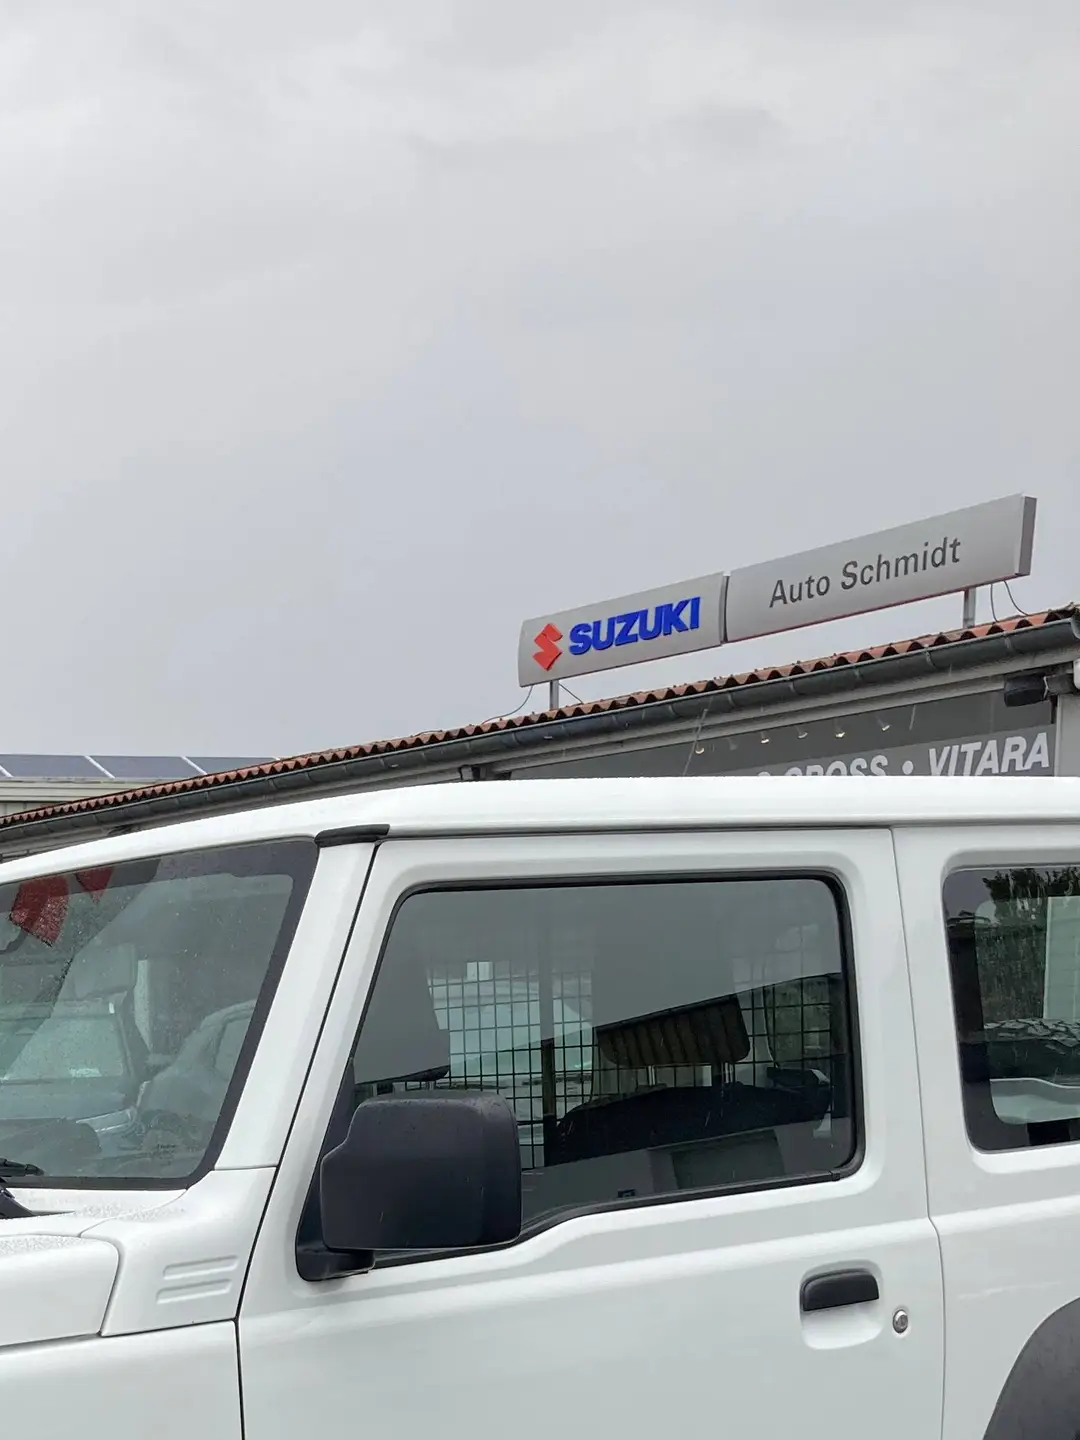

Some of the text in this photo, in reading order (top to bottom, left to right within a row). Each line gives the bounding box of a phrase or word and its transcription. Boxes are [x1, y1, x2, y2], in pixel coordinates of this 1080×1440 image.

[769, 537, 961, 609] Auto Schmidt
[568, 596, 701, 656] SUZUKI
[928, 732, 1050, 777] VITARA
